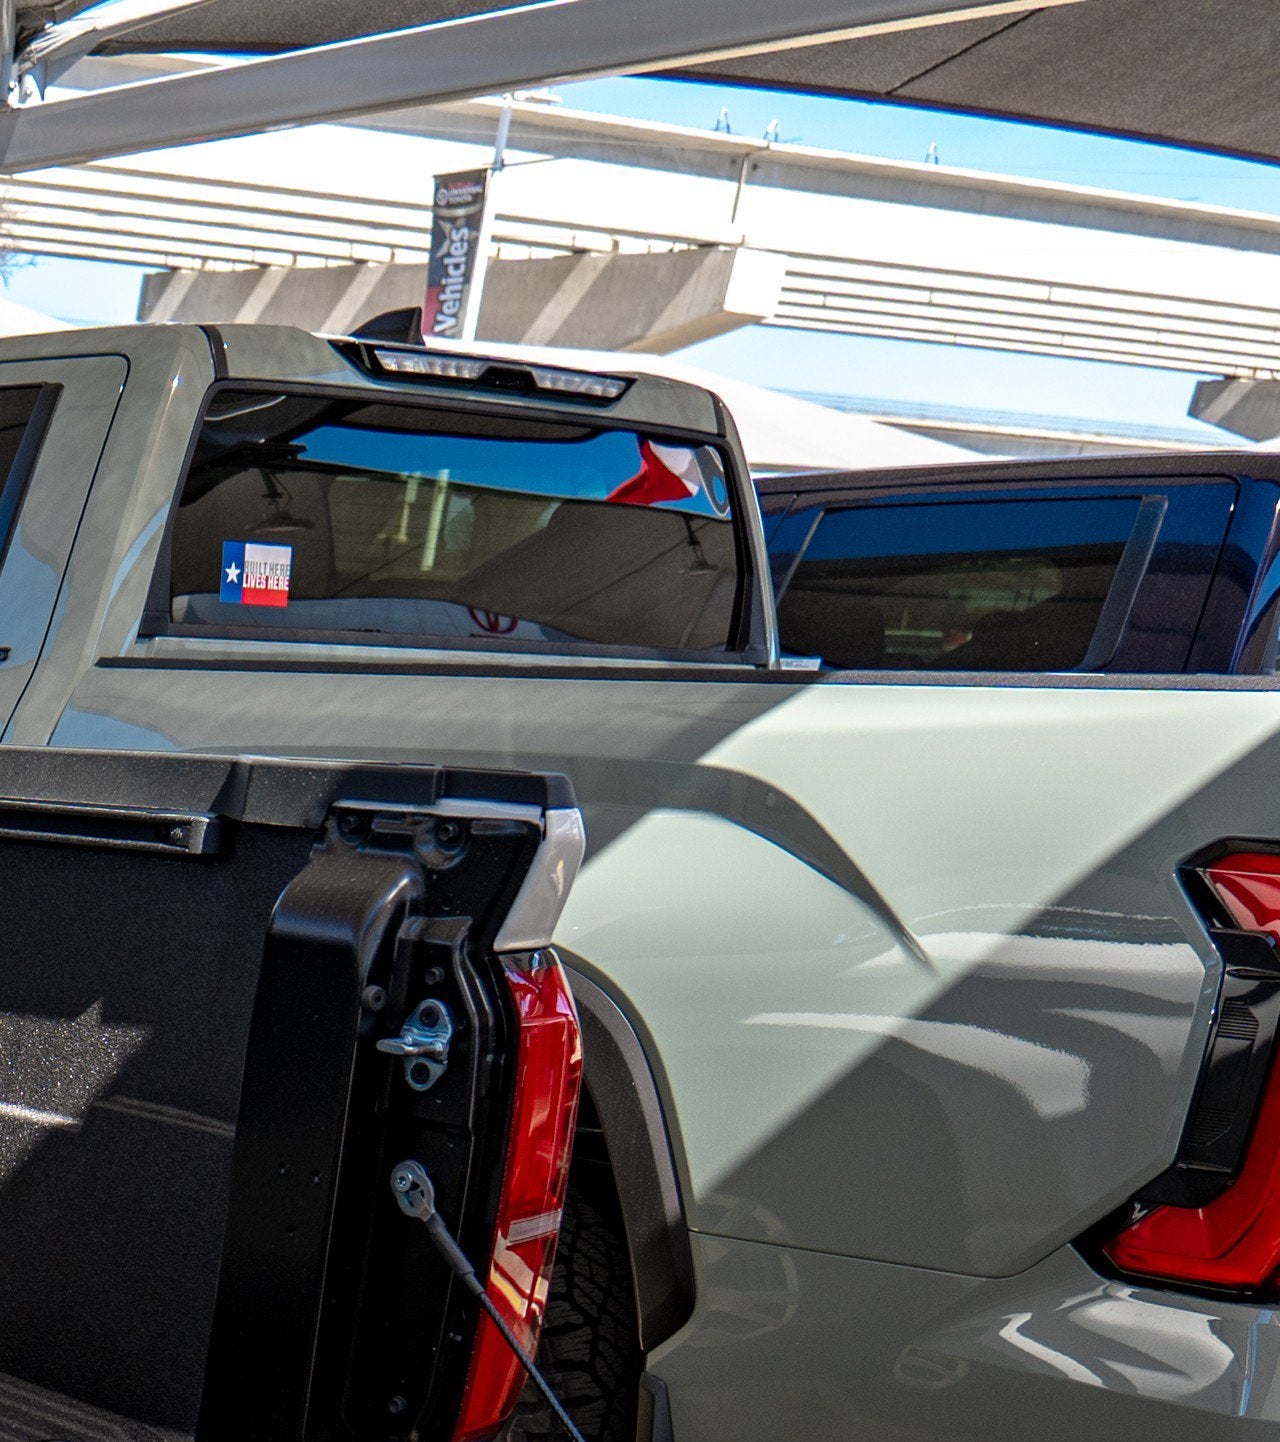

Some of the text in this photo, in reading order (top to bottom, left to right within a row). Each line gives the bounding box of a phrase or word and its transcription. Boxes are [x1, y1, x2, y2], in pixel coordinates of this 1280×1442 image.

[432, 225, 471, 333] Vehicles
[244, 560, 291, 578] BUILT HERE
[242, 573, 290, 591] LIVES HERE
